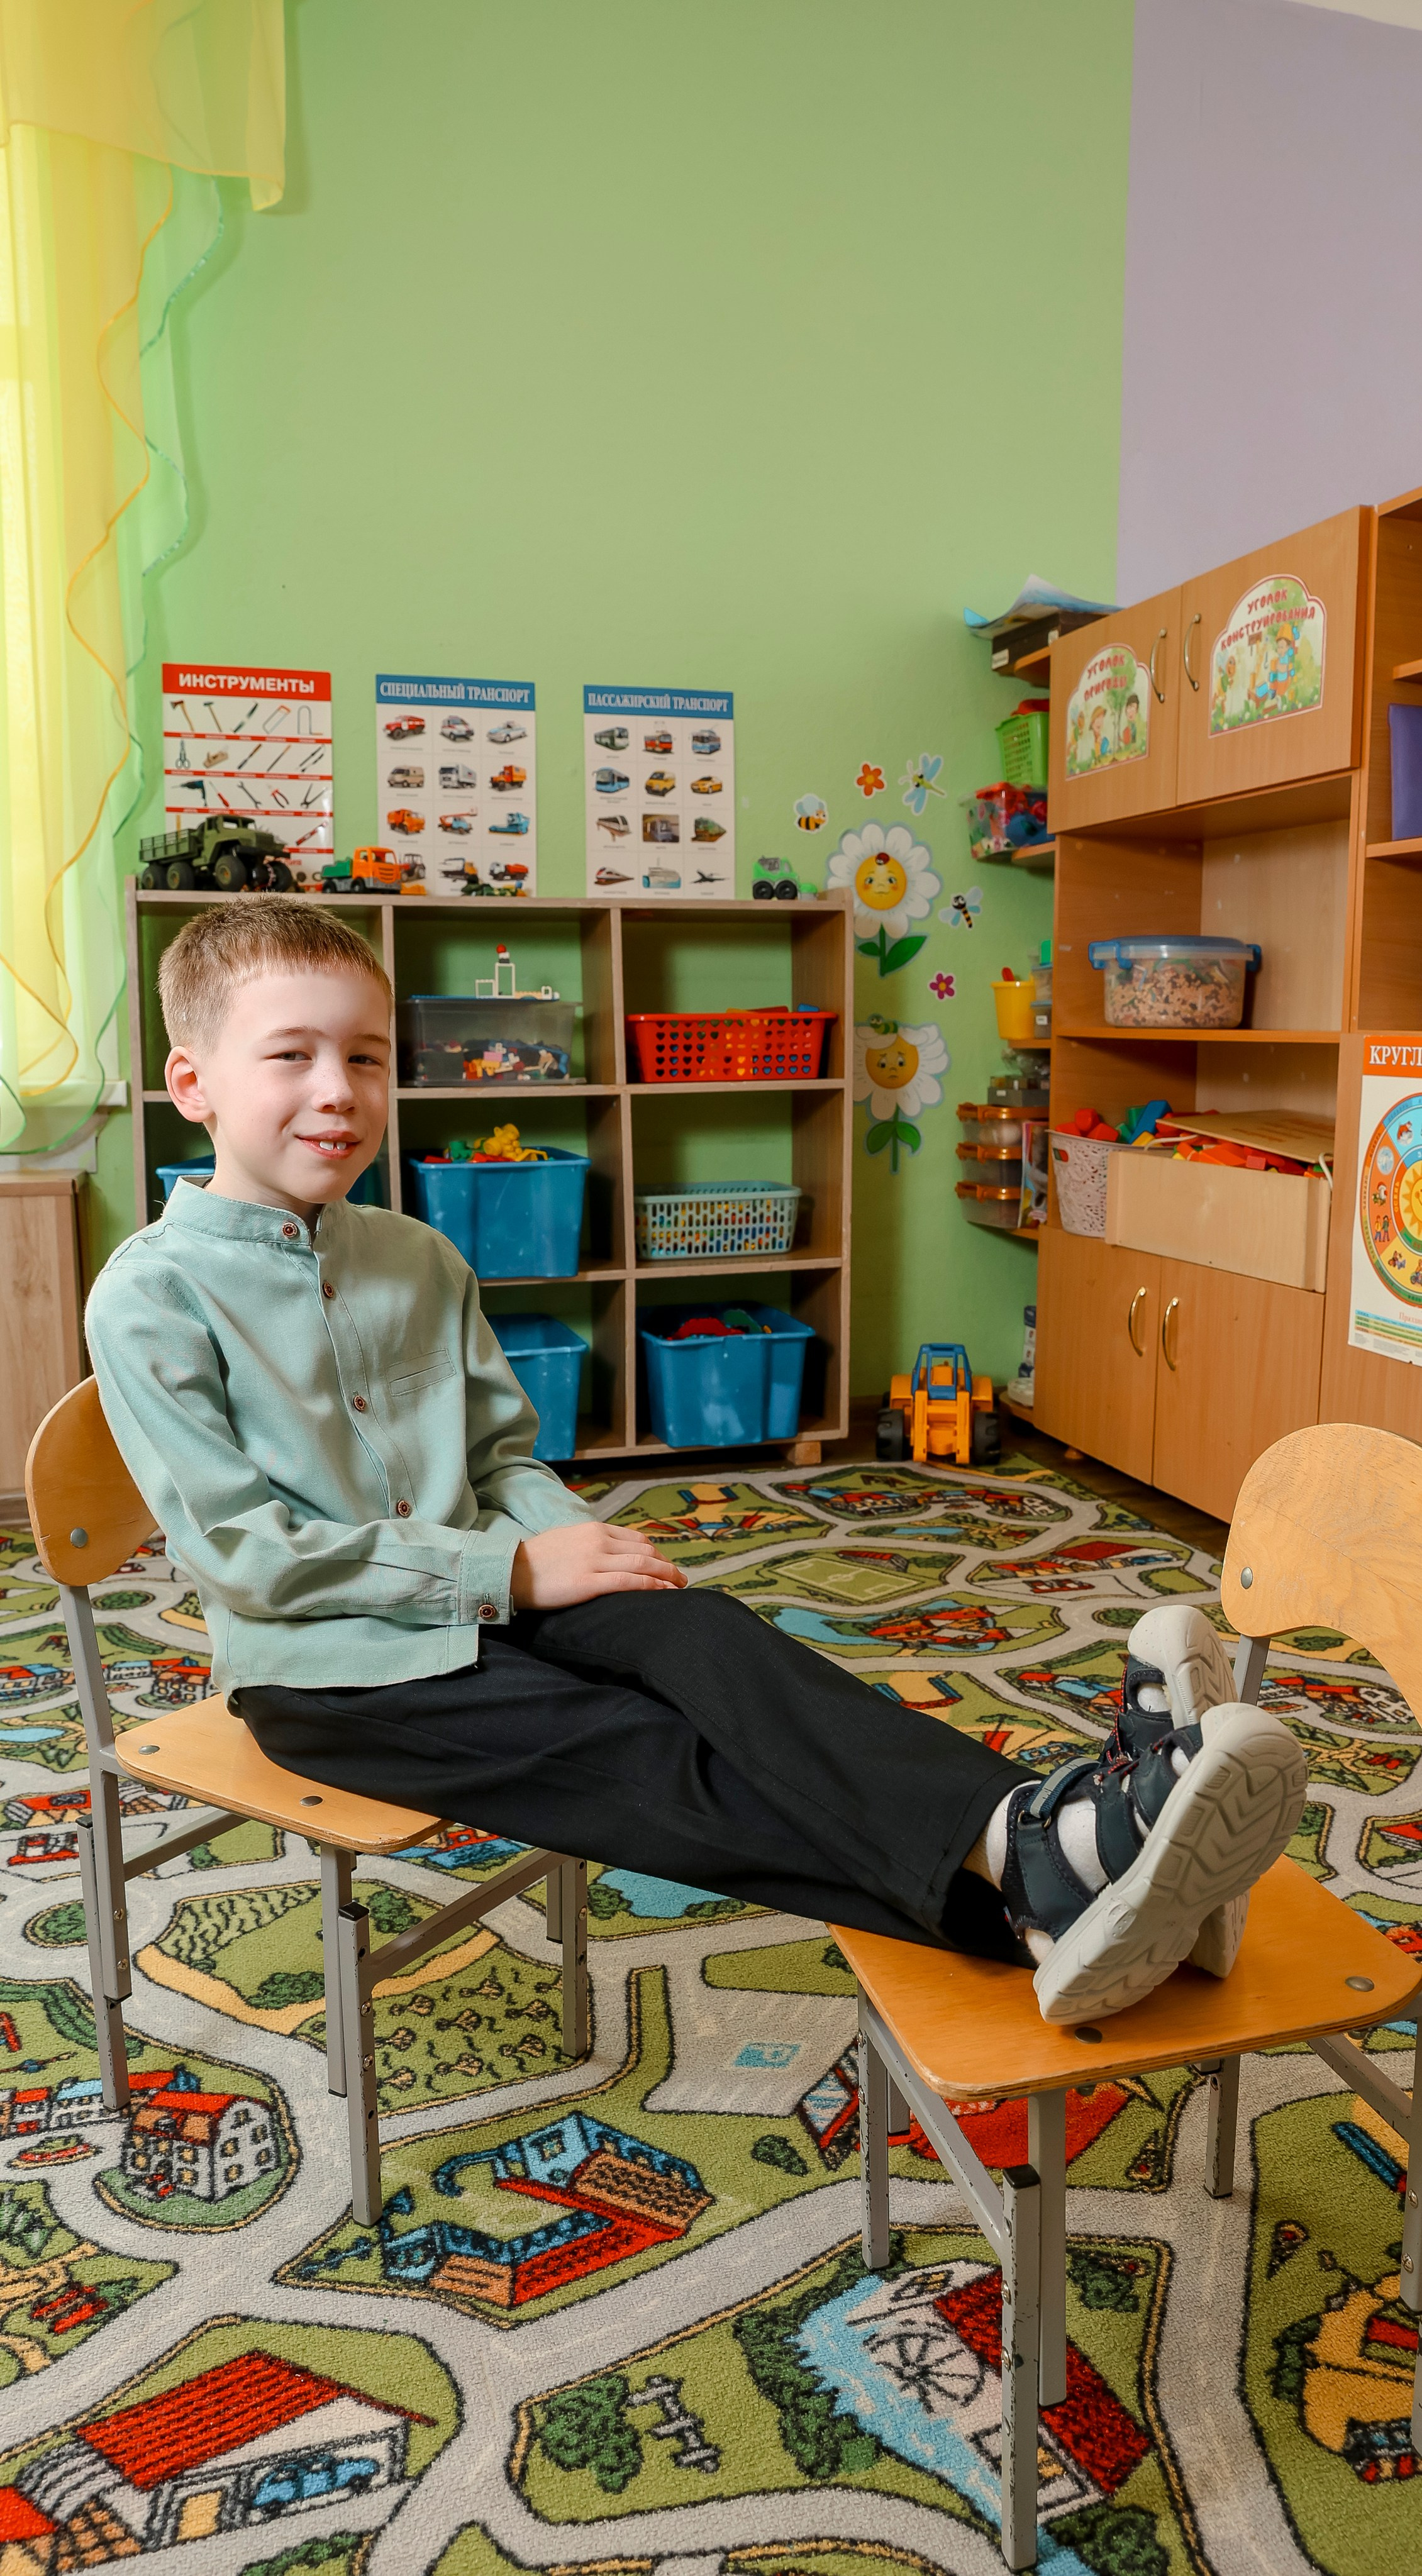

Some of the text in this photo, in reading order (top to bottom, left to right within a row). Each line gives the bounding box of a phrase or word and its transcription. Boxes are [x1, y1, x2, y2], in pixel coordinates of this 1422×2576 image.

[1248, 589, 1287, 614] УГОЛОК
[1221, 606, 1315, 650] КОНСТРУИРОВАНИЯ
[1087, 653, 1125, 679] УГОЛОК
[178, 672, 315, 693] ИНСТРУМЕНТЫ
[379, 682, 530, 703] СПЕЦИАЛЬНЫЙ ТРАНСПОРТ
[1084, 675, 1127, 702] ПРИРОДЫ
[588, 693, 728, 712] ПАССАЖИРСКИЙ ТРАНСПОРТ
